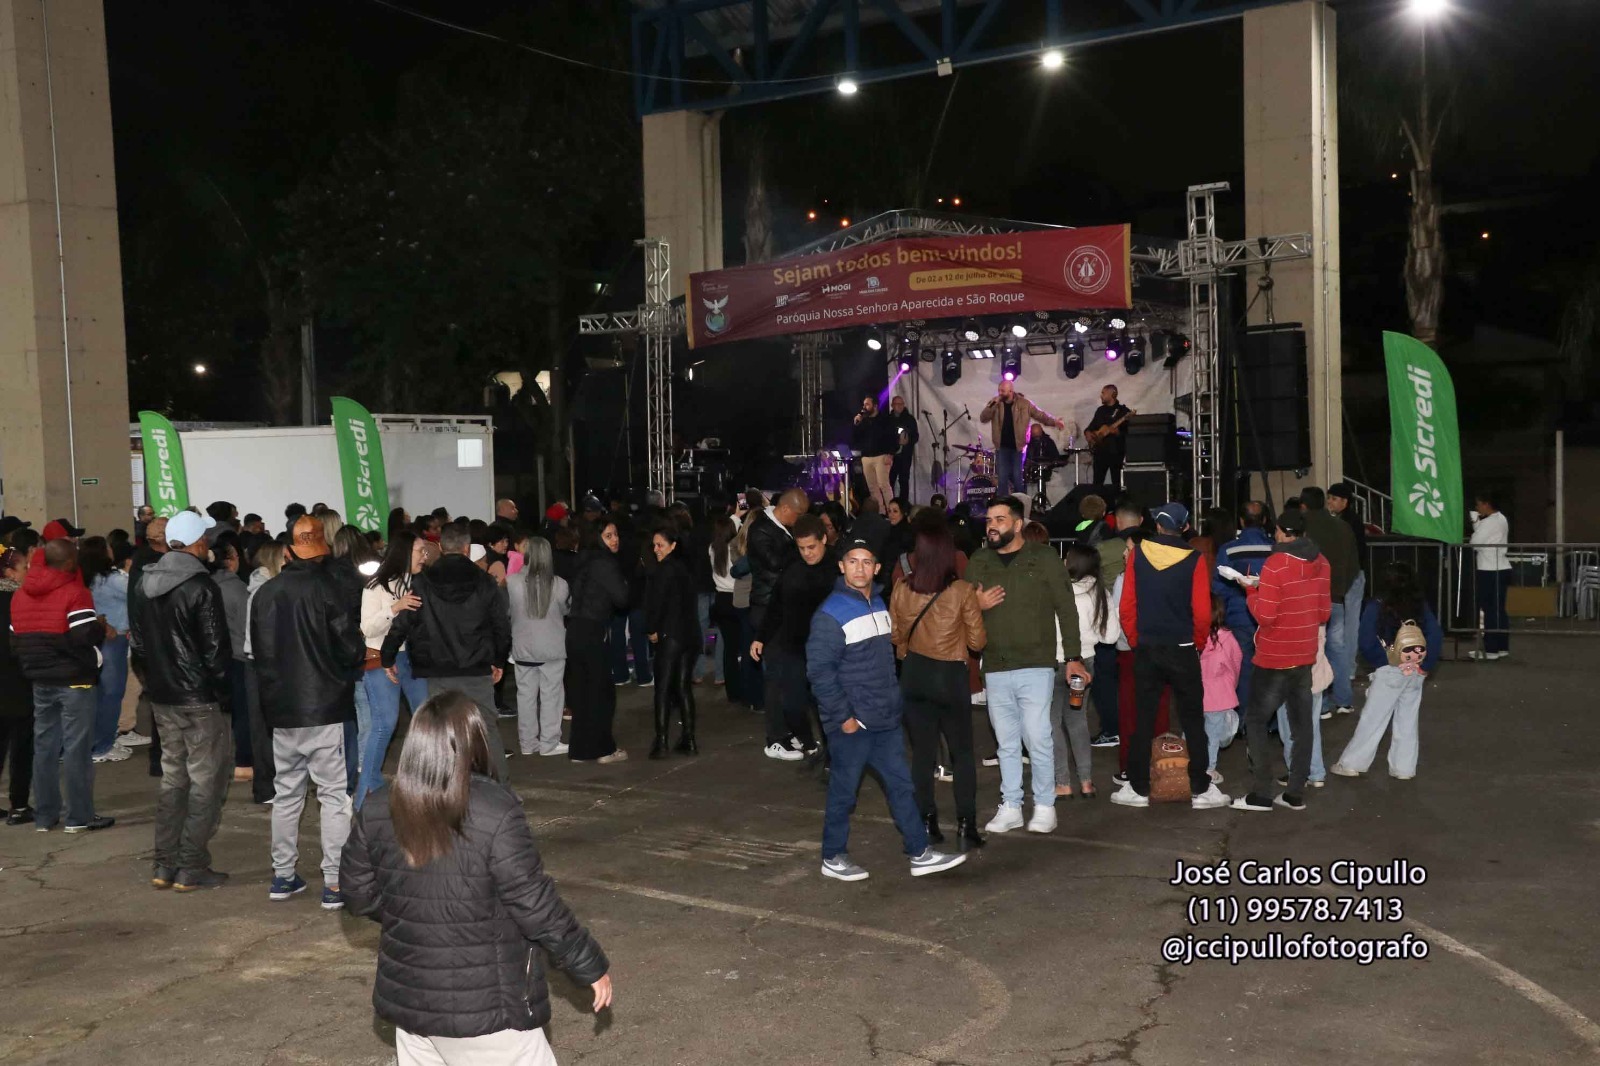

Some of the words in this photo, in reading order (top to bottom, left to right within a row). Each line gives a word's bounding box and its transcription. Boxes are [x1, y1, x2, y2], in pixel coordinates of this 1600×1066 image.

[773, 264, 832, 288] Sejam
[836, 252, 891, 273] todos
[897, 241, 1022, 264] bem-vindos!
[831, 283, 851, 293] MOGI
[776, 310, 821, 325] Paróquia
[823, 308, 854, 319] Nossa
[856, 302, 898, 315] Senhora
[901, 296, 954, 311] Aparecida
[957, 297, 963, 306] e
[966, 293, 986, 305] São
[989, 292, 1025, 305] Roque
[1407, 363, 1438, 479] Sicredi
[151, 428, 177, 501] Sicredi
[348, 418, 374, 501] Sicredi
